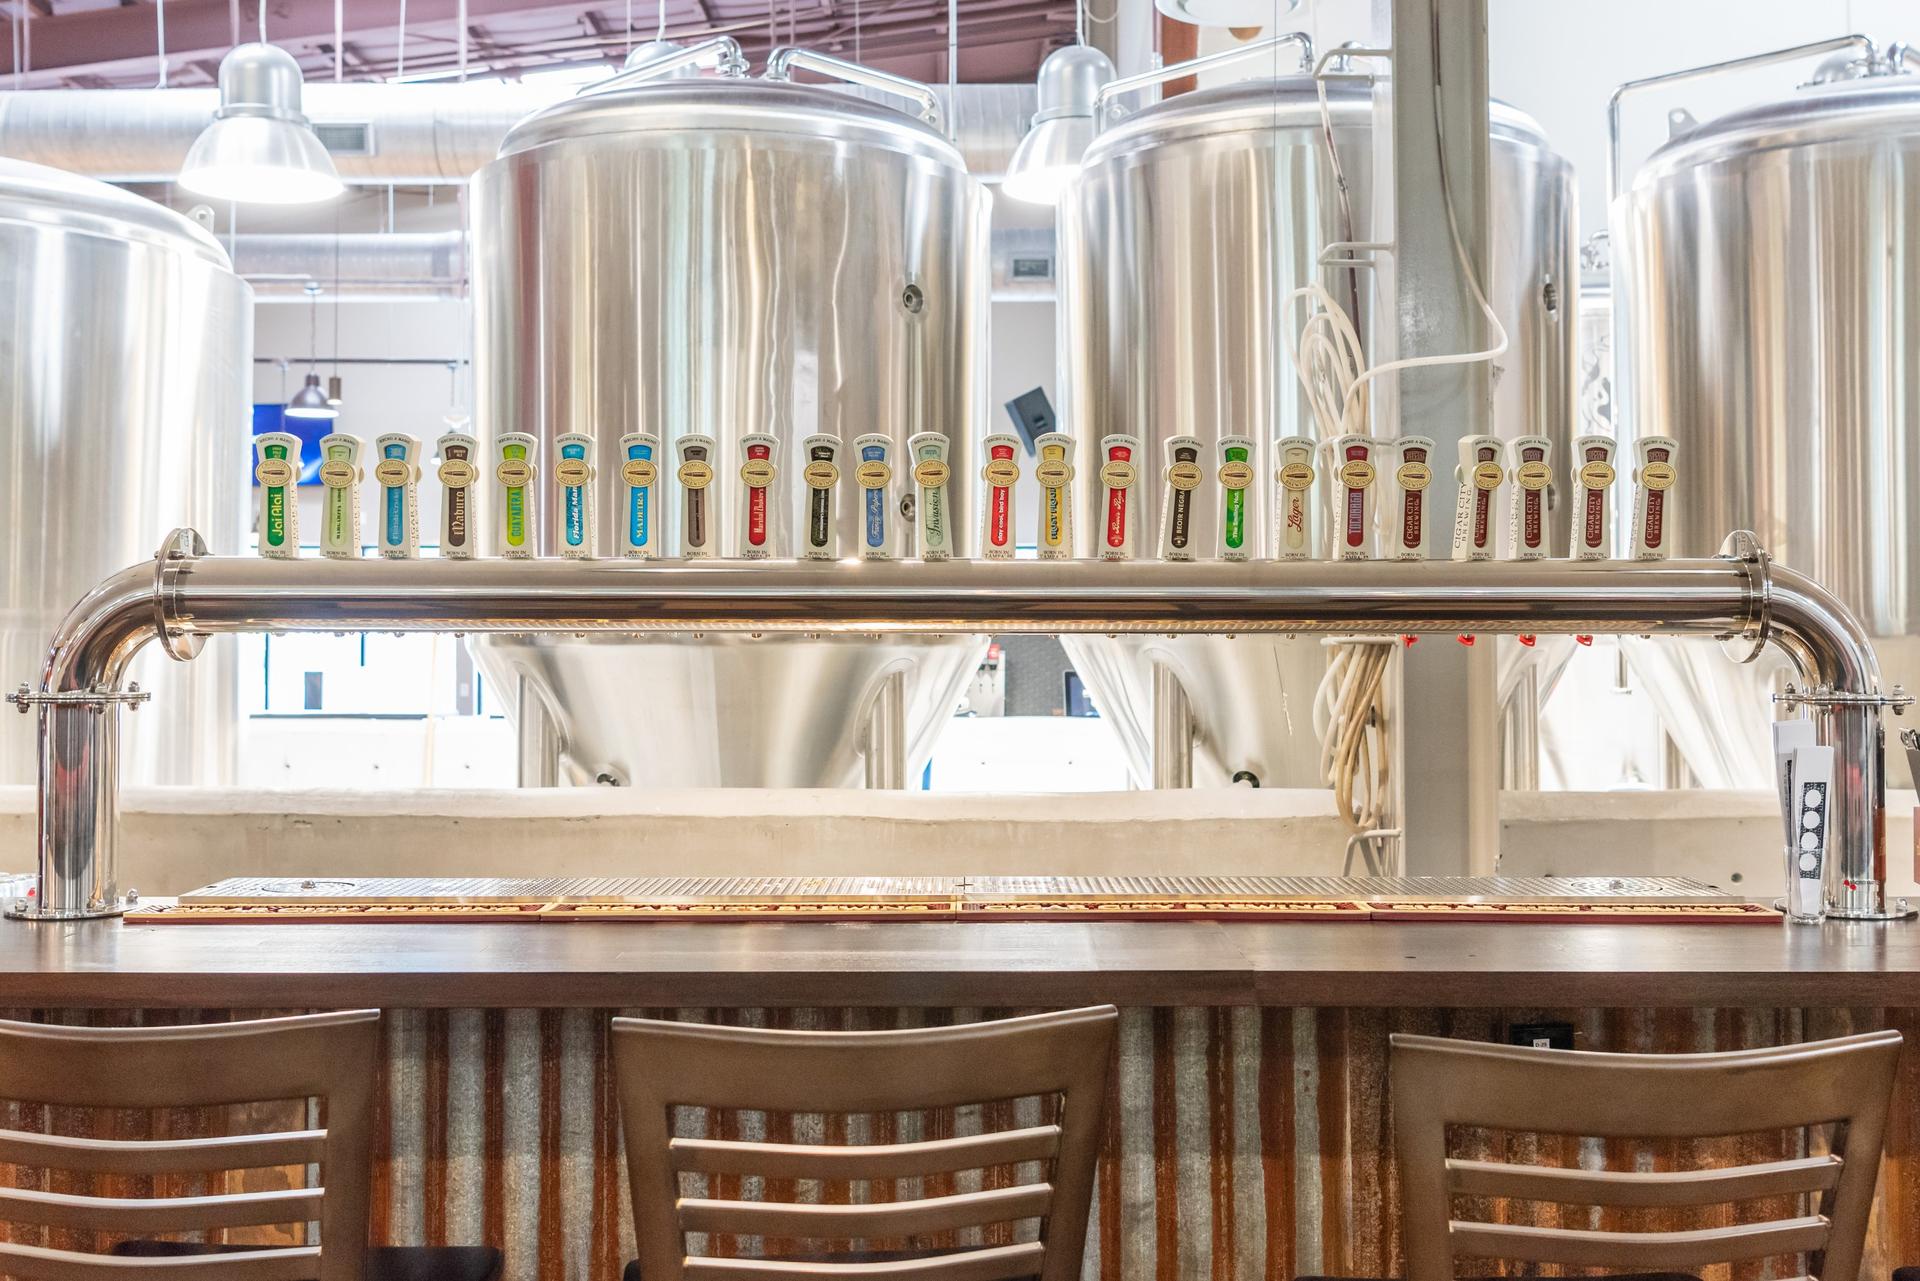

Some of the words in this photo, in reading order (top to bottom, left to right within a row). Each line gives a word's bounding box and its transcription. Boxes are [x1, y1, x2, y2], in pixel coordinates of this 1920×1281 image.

[271, 493, 282, 516] Alai
[452, 491, 464, 535] Maduro
[511, 491, 521, 537] GUAYABERA
[572, 507, 580, 539] Florida
[926, 492, 941, 536] Invasion
[1288, 497, 1303, 532] Lager
[1454, 512, 1463, 548] CIGAR
[1459, 482, 1467, 508] CITY
[272, 518, 282, 536] Jai
